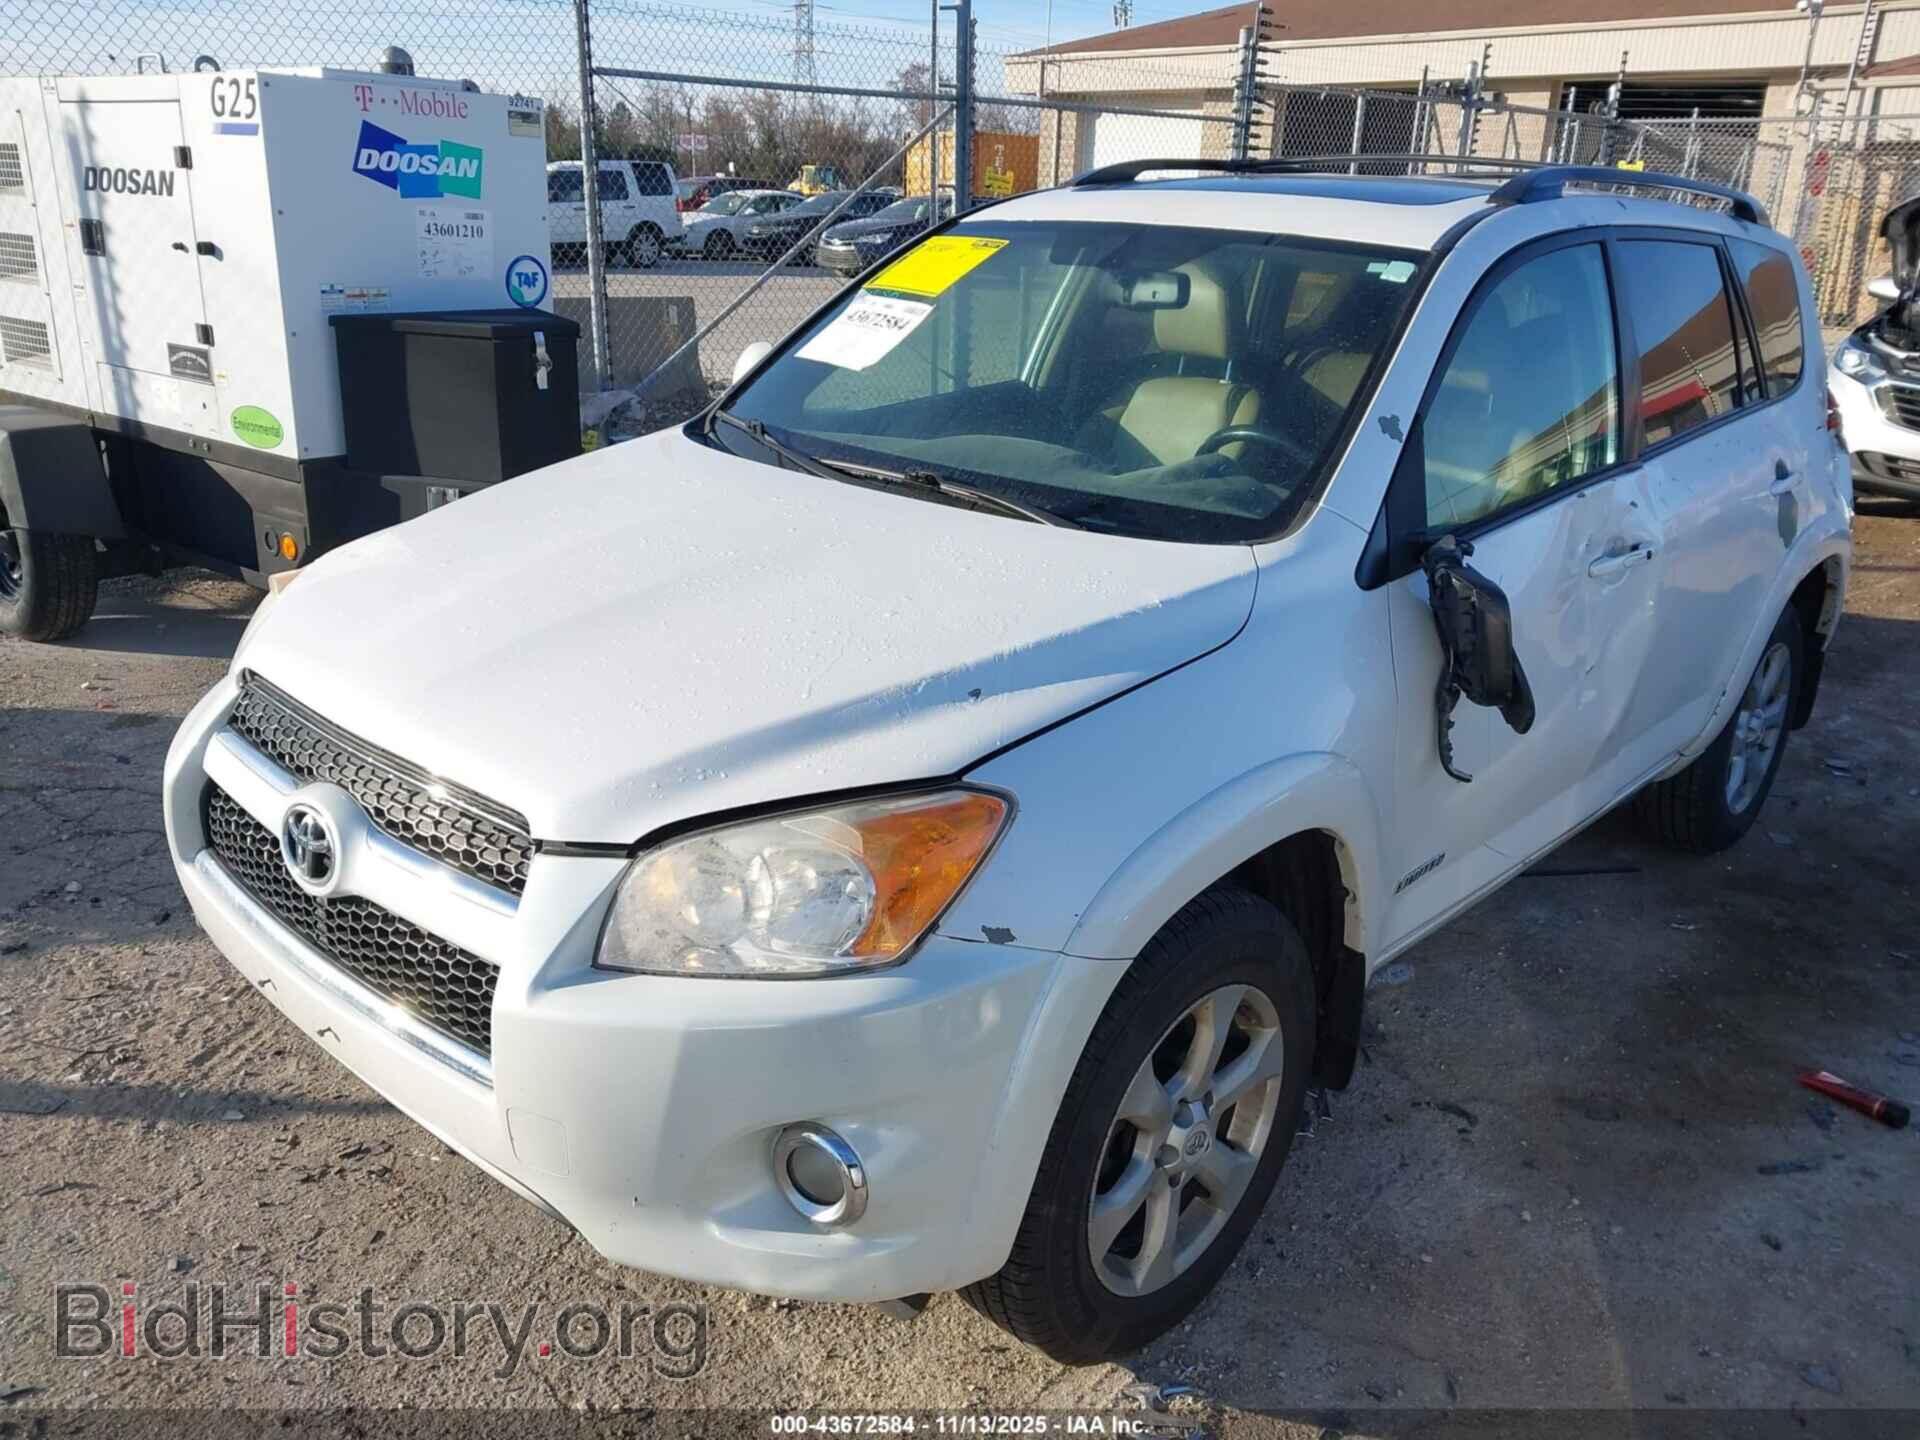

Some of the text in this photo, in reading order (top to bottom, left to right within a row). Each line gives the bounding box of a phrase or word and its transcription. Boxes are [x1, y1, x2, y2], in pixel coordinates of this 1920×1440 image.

[210, 76, 257, 119] G25
[357, 148, 480, 178] DOOSAN
[84, 165, 175, 197] DOOSAN
[424, 222, 485, 239] 43601210
